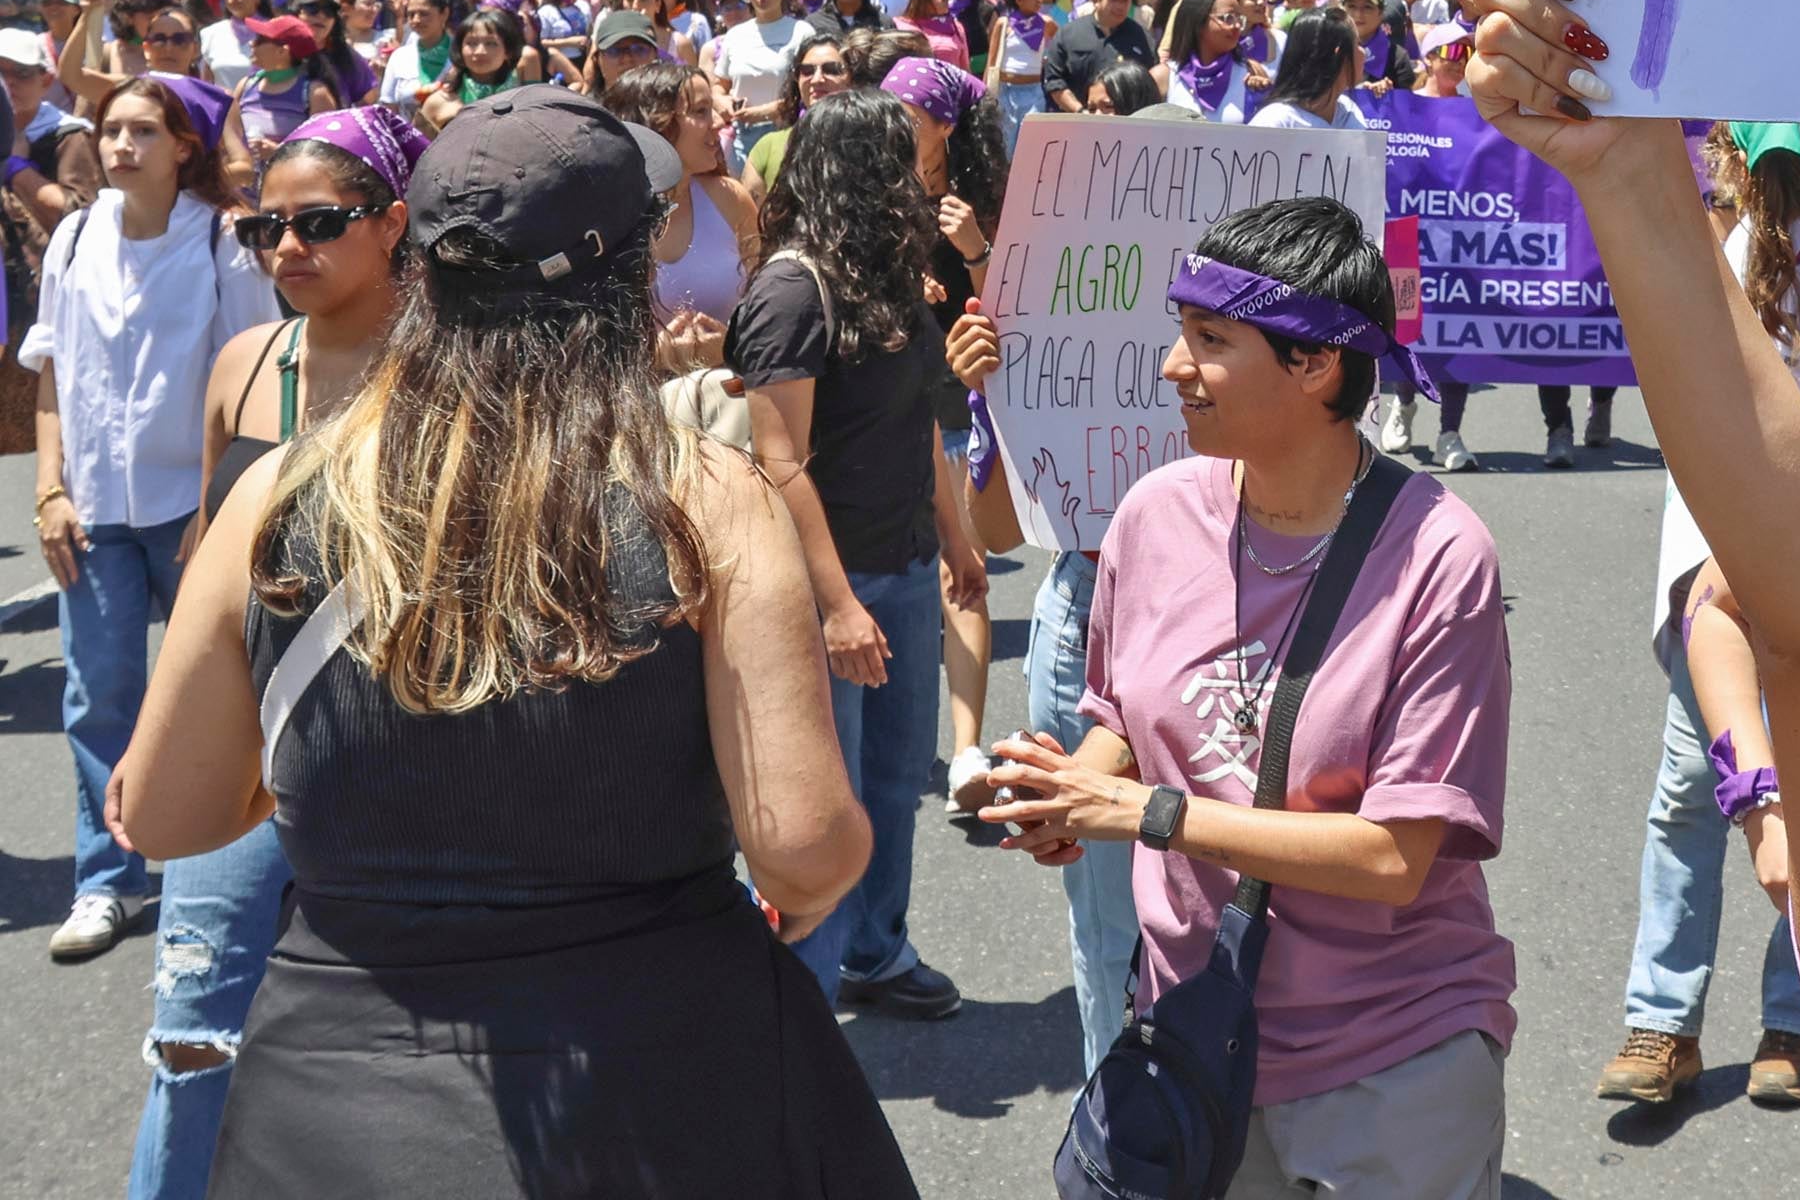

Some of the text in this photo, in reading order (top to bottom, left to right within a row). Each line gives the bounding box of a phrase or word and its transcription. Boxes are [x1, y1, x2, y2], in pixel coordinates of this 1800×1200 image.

[1387, 133, 1453, 149] ESIONALES
[1032, 140, 1067, 218] EL
[1400, 189, 1521, 224] MENOS,
[1451, 224, 1558, 267] MÁS!
[996, 243, 1030, 318] EL
[1050, 243, 1142, 316] AGRO
[1436, 320, 1484, 349] LA
[997, 332, 1095, 410] PLAGA
